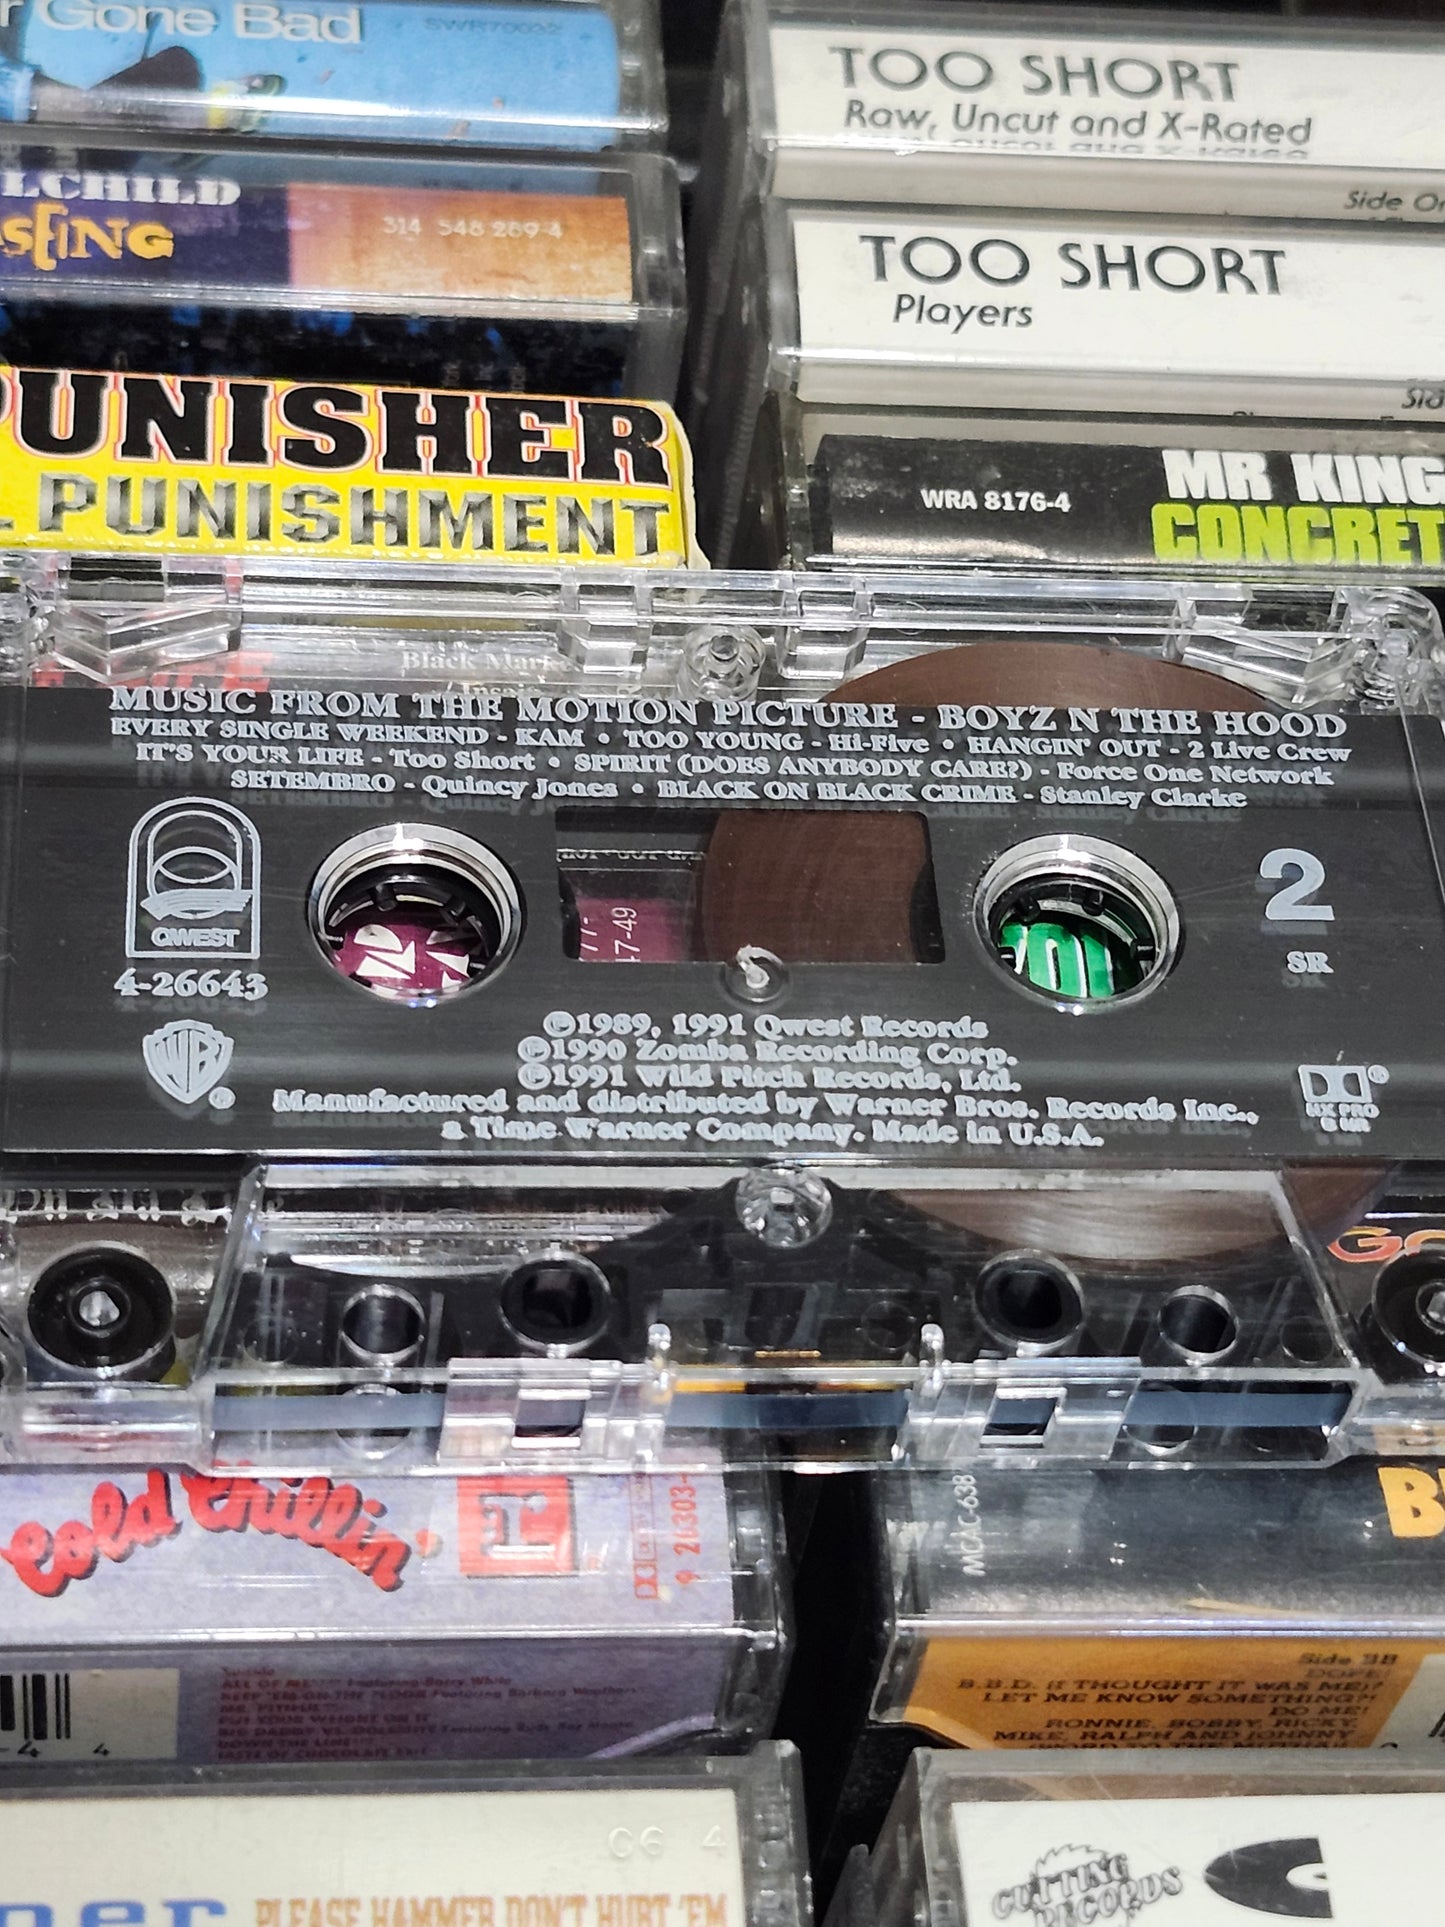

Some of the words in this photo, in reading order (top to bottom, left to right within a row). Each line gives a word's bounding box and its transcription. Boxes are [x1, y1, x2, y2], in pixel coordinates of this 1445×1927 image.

[39, 0, 218, 36] Gone
[234, 2, 363, 44] Bad
[828, 46, 994, 93] TOO
[1020, 53, 1240, 102] SHORT
[845, 99, 938, 135] Raw,
[953, 102, 1061, 137] Uncut
[1070, 110, 1148, 138] and
[1158, 111, 1313, 145] X-Rated
[1344, 190, 1403, 211] Side
[383, 216, 422, 236] 314
[860, 235, 1030, 287] TOO
[1060, 242, 1287, 296] SHORT
[894, 293, 1033, 335] Players
[0, 367, 673, 489] UNISHER
[1162, 449, 1273, 502] MR
[39, 472, 670, 556] PUNISHMENT
[920, 488, 977, 511] WRA
[984, 490, 1070, 513] 8176-4
[1151, 504, 1445, 566] CONCRET
[109, 685, 257, 715] MUSIC
[270, 690, 401, 718] FROM
[412, 693, 503, 721] THE
[517, 696, 699, 725] MOTION
[712, 700, 898, 727] PICTURE
[937, 704, 1058, 731] BOYZ
[1069, 707, 1100, 733] N
[1111, 708, 1201, 735] THE
[1213, 711, 1347, 738] HOOD
[111, 717, 213, 737] EVERY
[220, 720, 329, 741] SINGLE
[336, 723, 489, 745] WEEKEND
[515, 728, 585, 747] KAM
[624, 730, 689, 749] TOO
[696, 731, 804, 751] YOUNG
[829, 733, 930, 753] Hi-Five
[967, 736, 1090, 757] HANGIN'
[1100, 739, 1161, 758] OUT
[1187, 740, 1205, 759] 2
[1212, 741, 1271, 761] Live
[1276, 743, 1352, 763] Crew
[136, 742, 194, 762] IT'S
[201, 745, 292, 764] YOUR
[298, 746, 364, 766] LIFE
[389, 748, 447, 769] Too
[454, 750, 536, 771] Short
[574, 753, 671, 773] SPIRIT
[677, 754, 770, 776] (DOES
[778, 756, 924, 777] ANYBODY
[931, 760, 1032, 781] CARE?)
[1057, 761, 1138, 781] Force
[1144, 764, 1204, 783] One
[1210, 765, 1334, 785] Network
[230, 770, 396, 792] SETEMBRO
[421, 774, 529, 799] Quincy
[532, 778, 619, 800] Jones
[657, 779, 760, 800] BLACK
[763, 781, 810, 800] ON
[817, 783, 915, 801] BLACK
[921, 784, 1018, 803] CRIME
[1040, 786, 1145, 810] Stanley
[1150, 787, 1248, 808] Clarke
[1259, 848, 1336, 921] 2
[151, 927, 240, 948] QWEST
[1286, 950, 1334, 974] SR
[114, 967, 269, 1000] 4-26643
[672, 1013, 747, 1038] 1991
[754, 1014, 855, 1041] Qwest
[860, 1015, 990, 1039] Records
[636, 1037, 749, 1062] Zomba
[755, 1040, 921, 1069] Recording
[926, 1042, 1018, 1070] Corp.
[635, 1064, 715, 1088] Wild
[721, 1064, 807, 1089] Pitch
[812, 1066, 952, 1094] Records,
[959, 1067, 1022, 1092] Ltd.
[272, 1087, 510, 1113] Manufactured
[517, 1089, 581, 1113] and
[587, 1089, 771, 1115] distributed
[774, 1090, 819, 1120] by
[824, 1092, 948, 1117] Warner
[954, 1094, 1040, 1119] Bros.
[1046, 1097, 1176, 1121] Records
[441, 1120, 468, 1140] a
[470, 1115, 562, 1141] Time
[564, 1116, 691, 1141] Warner
[872, 1119, 959, 1144] Made
[966, 1120, 1002, 1145] in
[1008, 1122, 1105, 1147] U.S.A.
[1377, 1466, 1445, 1538] B
[982, 1692, 1038, 1703] LET
[1043, 1692, 1088, 1703] ME
[1095, 1692, 1181, 1703] KNOW
[1073, 1679, 1212, 1691] THOUGHT
[1216, 1680, 1247, 1691] IT
[1254, 1681, 1310, 1691] WAS
[1269, 1706, 1309, 1717] DO
[1079, 1731, 1175, 1741] RALPH
[1179, 1730, 1240, 1741] AND
[1246, 1729, 1356, 1741] JOHNNY
[370, 1896, 496, 1927] HAMMER
